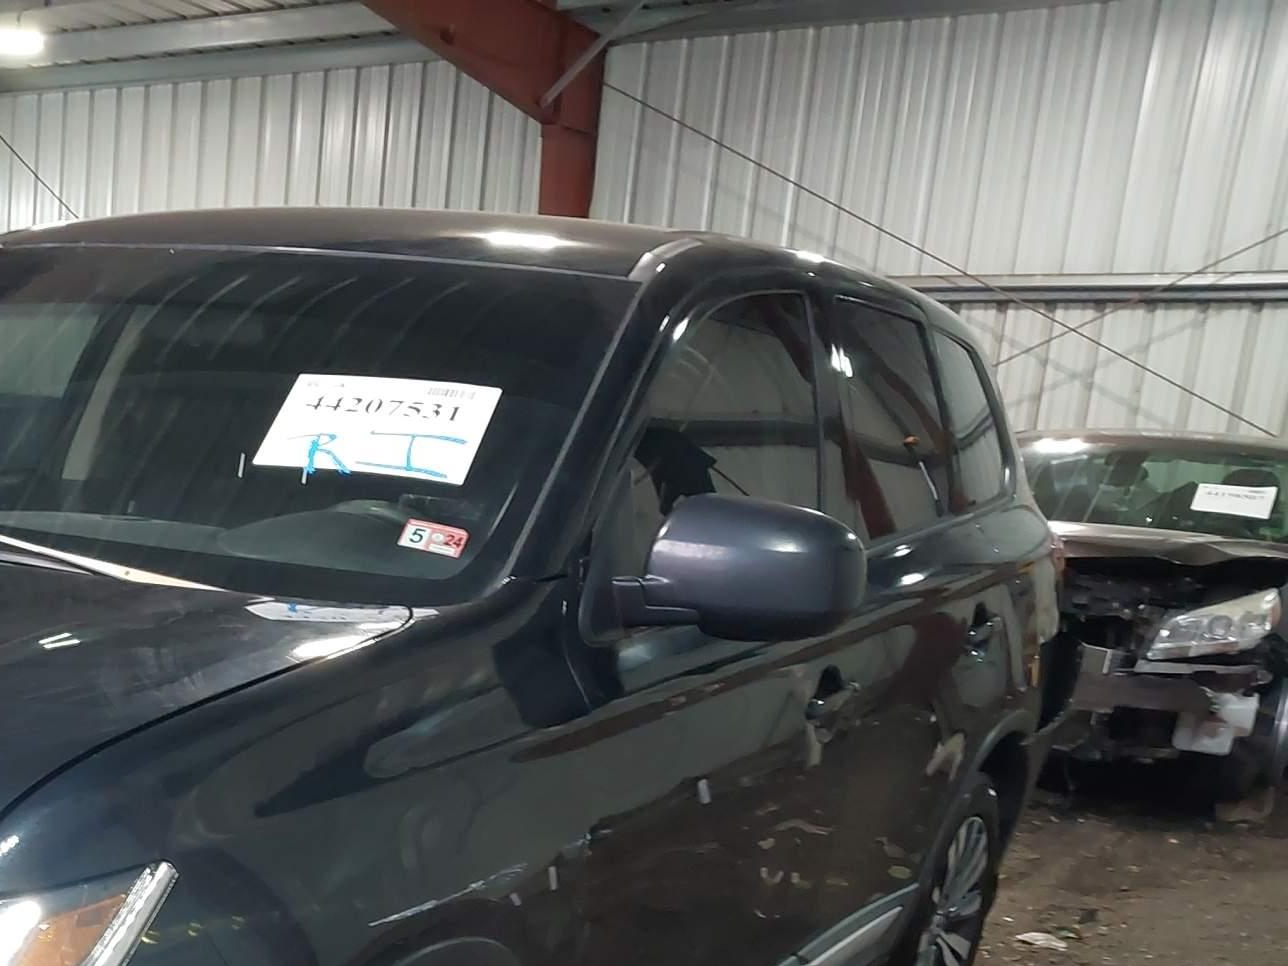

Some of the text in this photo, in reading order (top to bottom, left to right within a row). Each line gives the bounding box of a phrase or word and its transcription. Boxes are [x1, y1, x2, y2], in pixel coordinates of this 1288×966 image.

[305, 395, 462, 422] 44207531
[408, 527, 465, 549] 5 24
